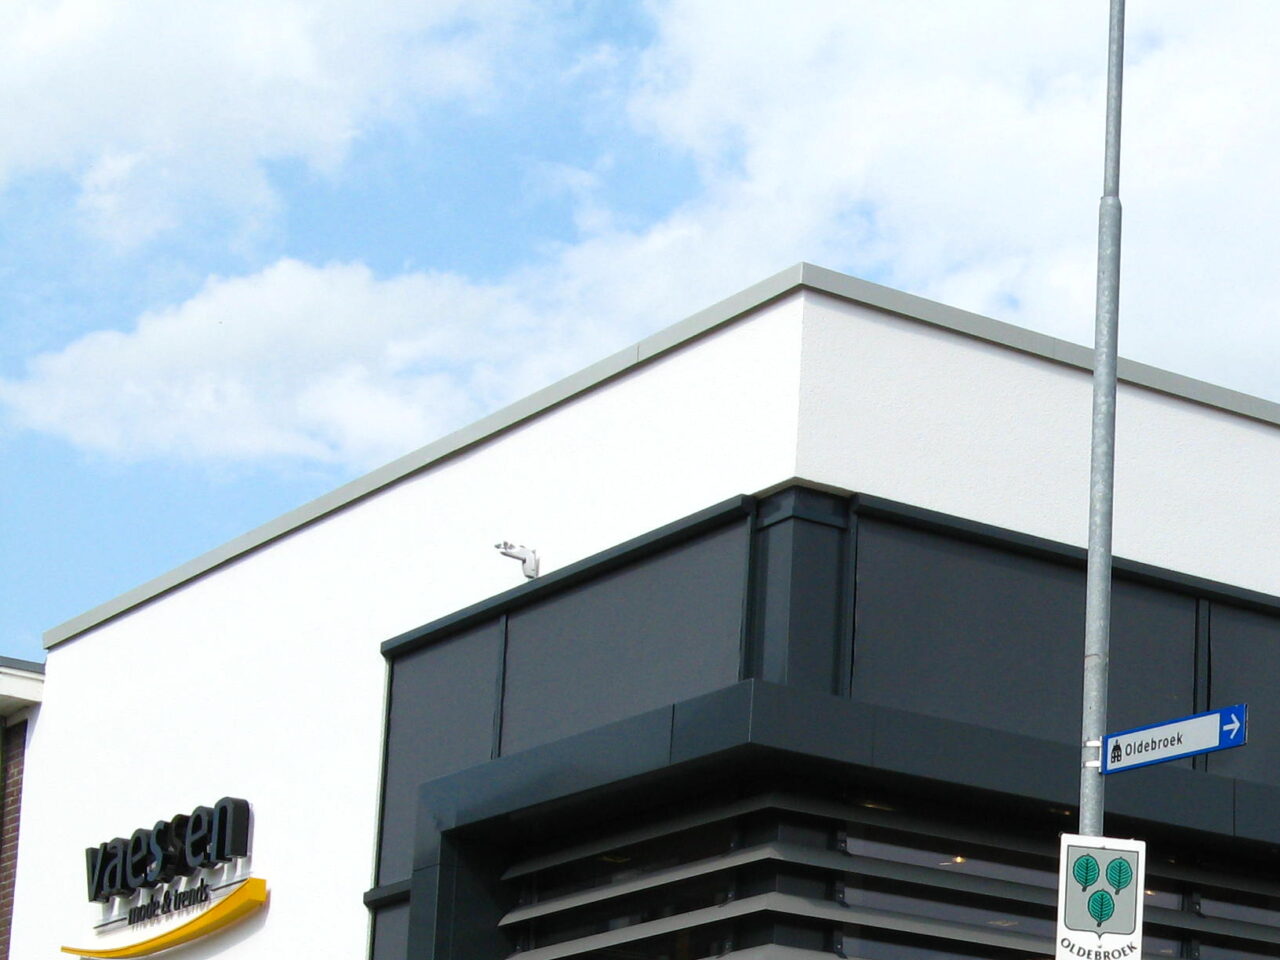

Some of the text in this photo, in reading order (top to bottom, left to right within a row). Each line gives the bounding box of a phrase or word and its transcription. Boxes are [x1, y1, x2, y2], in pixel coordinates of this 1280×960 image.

[1124, 732, 1183, 757] Oldebroek
[85, 796, 251, 903] vaessen
[128, 878, 210, 926] mode & trends
[1060, 937, 1138, 960] OLDEBROEK
